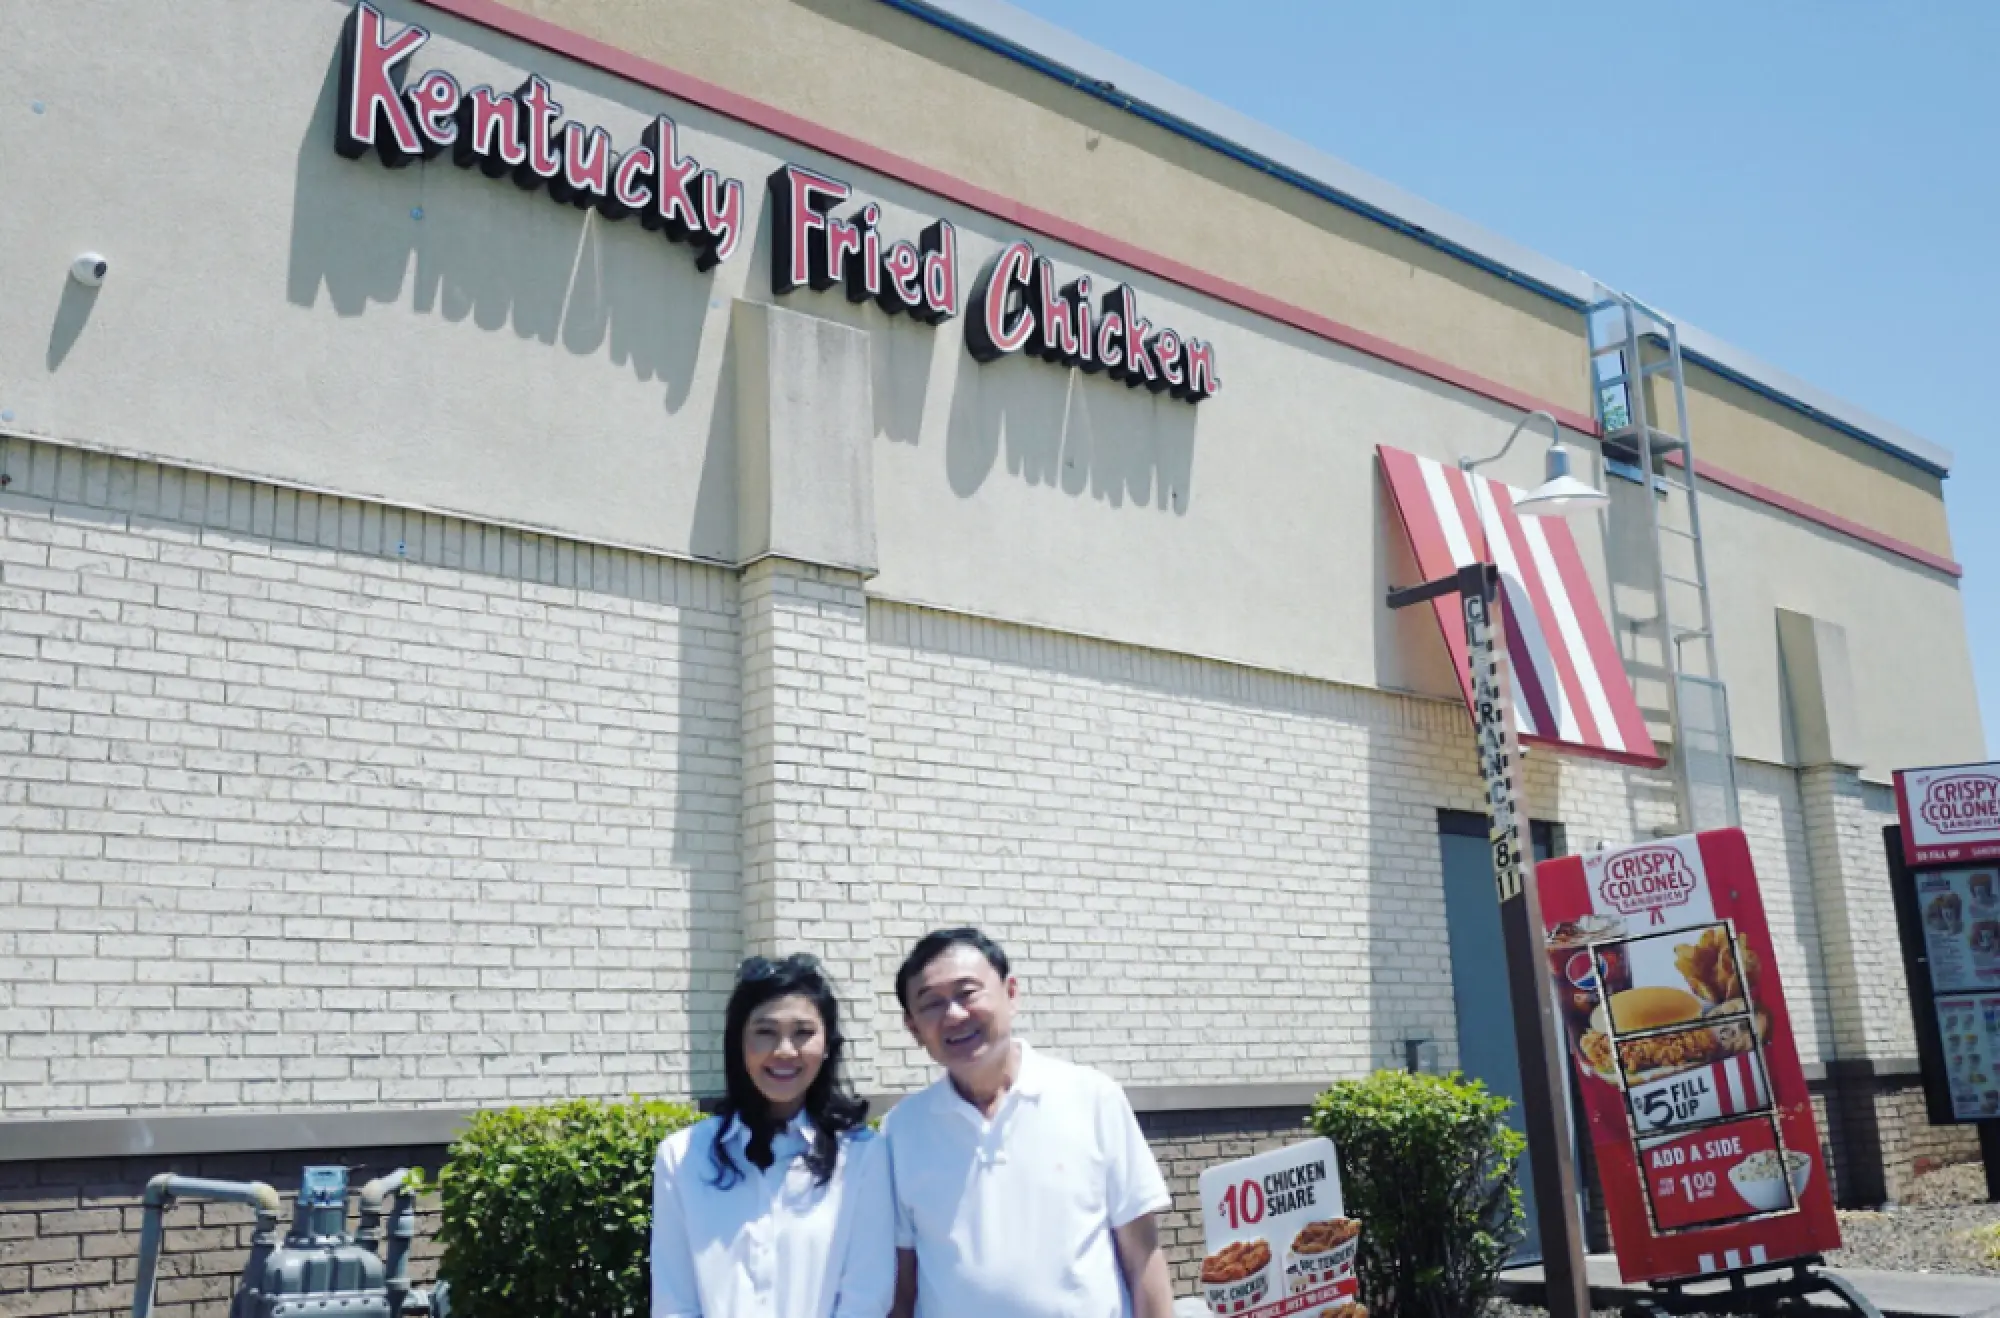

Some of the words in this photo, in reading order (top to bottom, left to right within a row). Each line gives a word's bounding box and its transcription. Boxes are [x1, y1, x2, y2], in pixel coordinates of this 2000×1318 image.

[349, 1, 744, 263] Kentucky
[785, 163, 958, 318] Fried
[983, 240, 1220, 396] Chicken
[1934, 780, 1998, 803] CRISPY
[1611, 853, 1675, 879] CRISPY
[1607, 870, 1690, 899] COLONEL
[1669, 1076, 1710, 1103] FILL
[1675, 1099, 1699, 1119] UP
[1652, 1146, 1685, 1169] ADD
[1689, 1143, 1703, 1162] A
[1704, 1135, 1743, 1159] SIDE
[1218, 1178, 1265, 1230] $10
[1263, 1159, 1327, 1195] CHICKEN
[1266, 1185, 1317, 1217] SHARE
